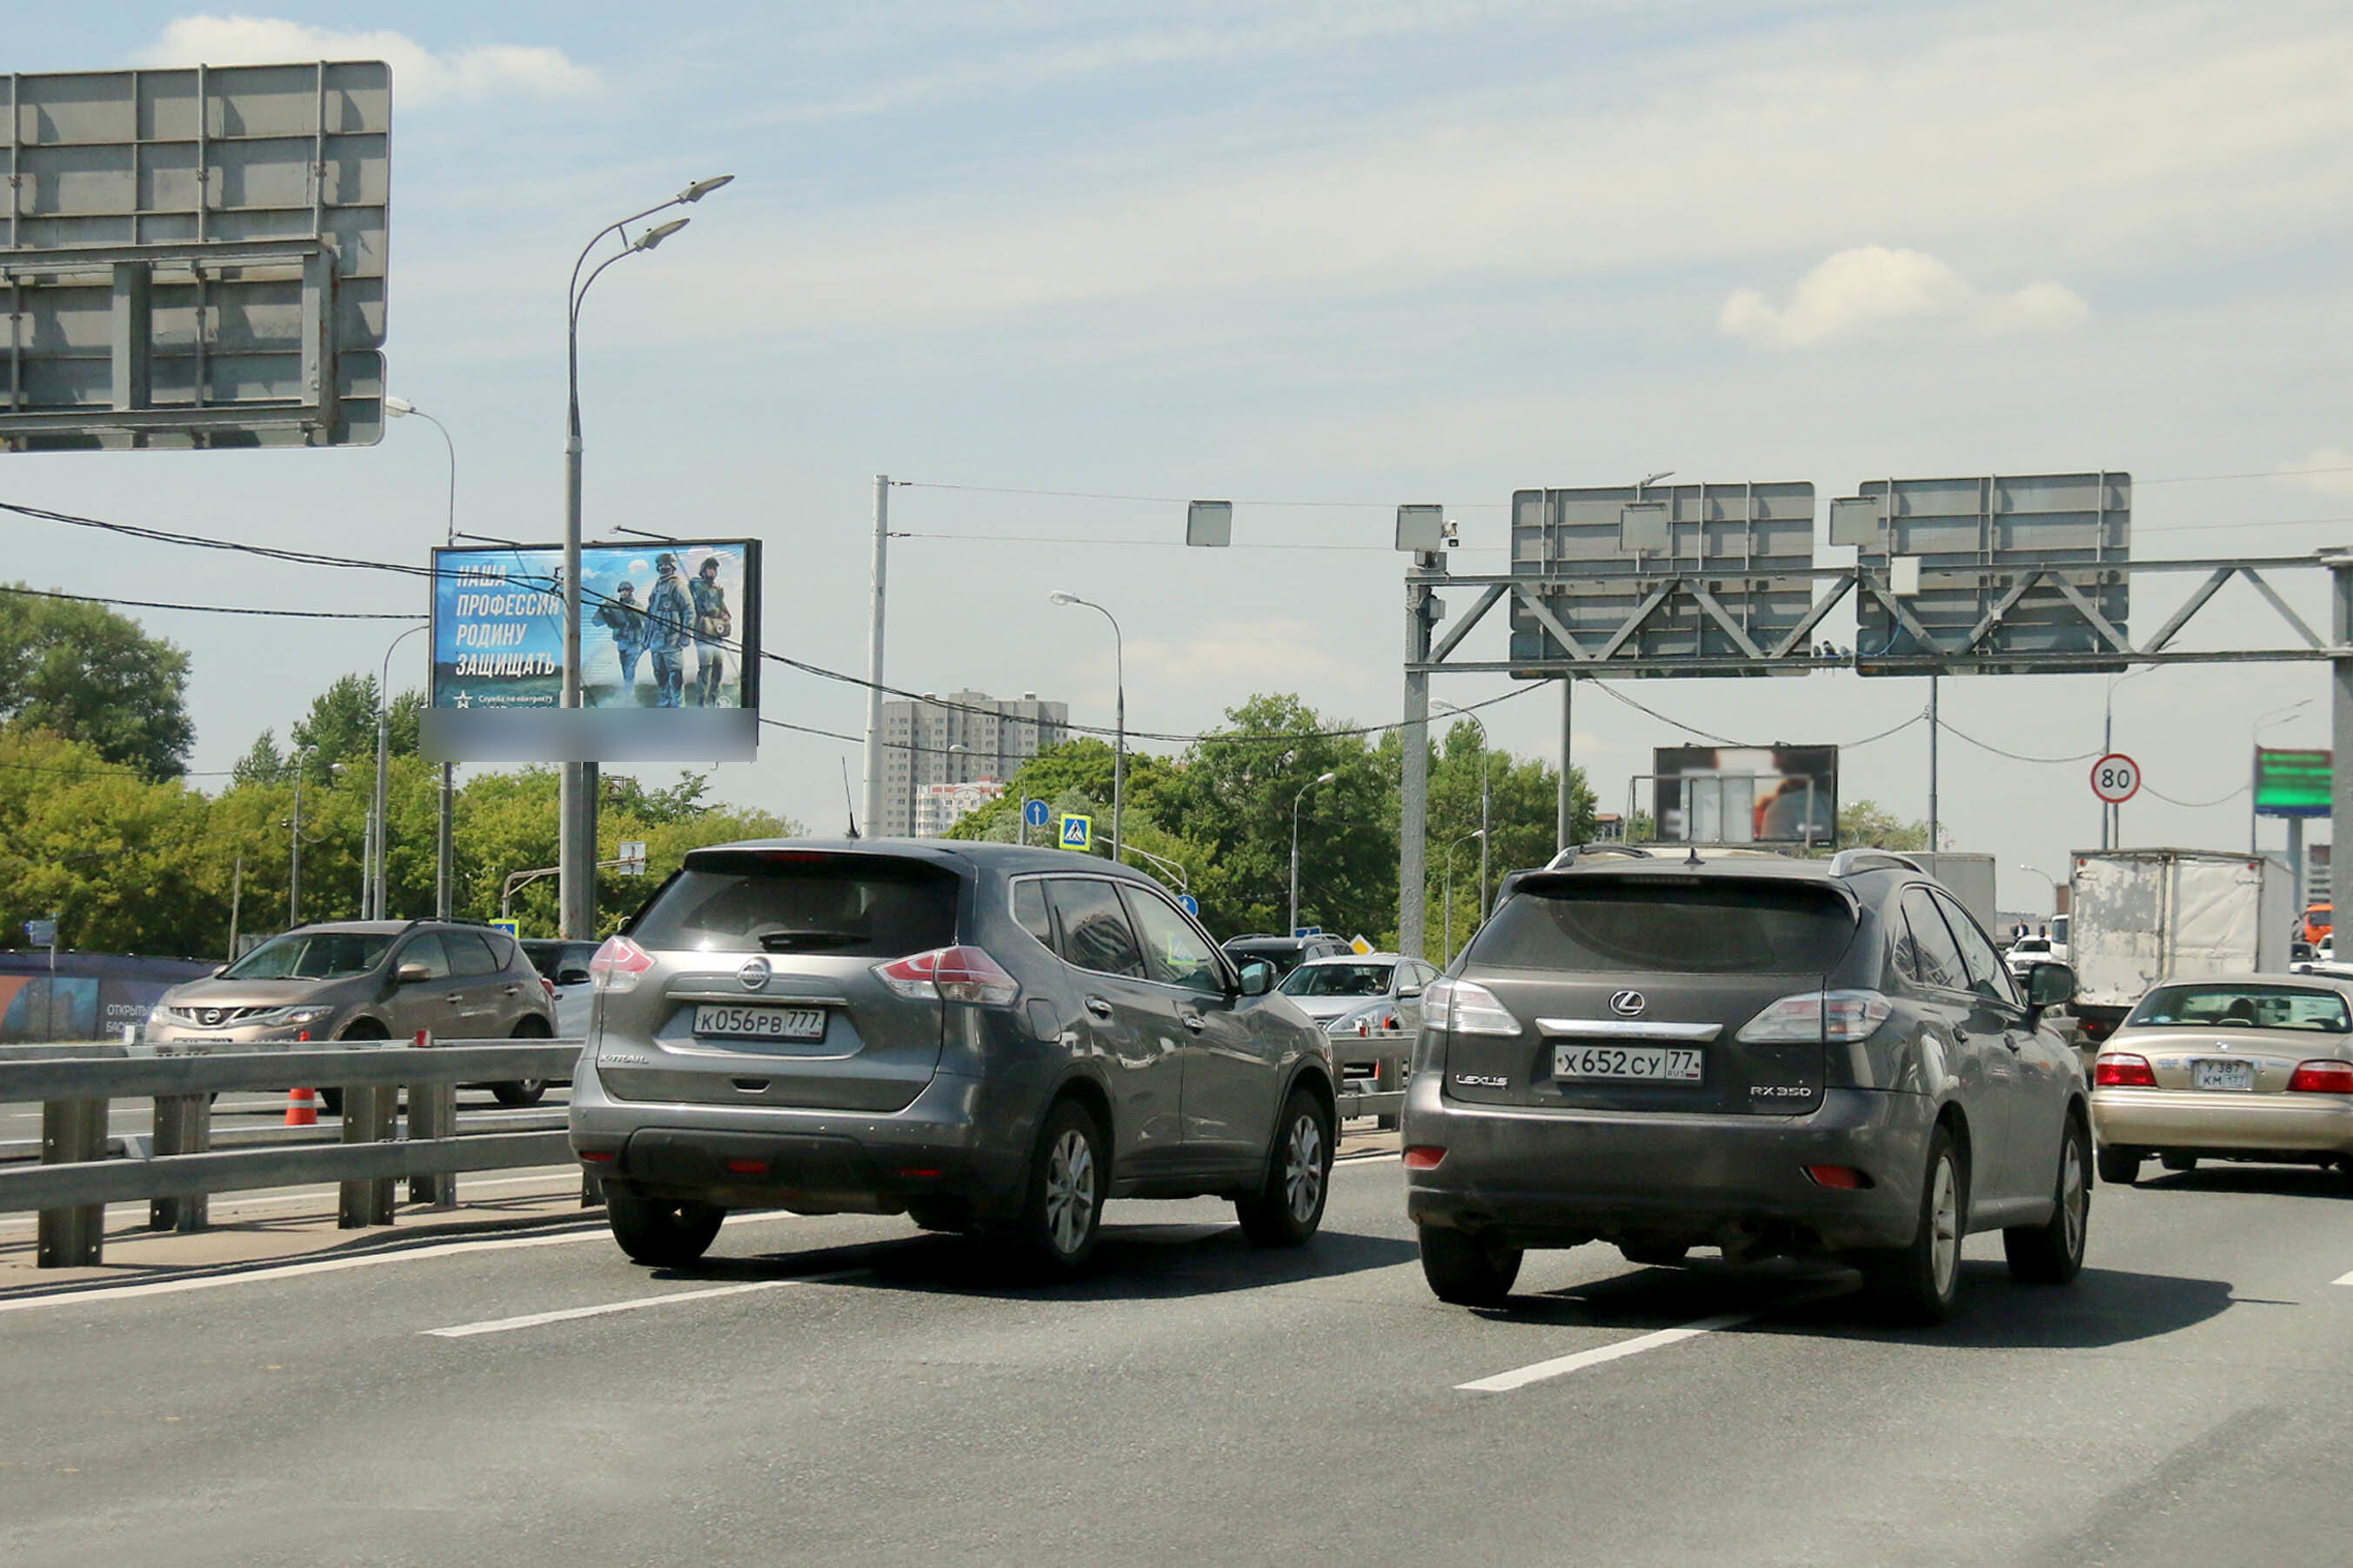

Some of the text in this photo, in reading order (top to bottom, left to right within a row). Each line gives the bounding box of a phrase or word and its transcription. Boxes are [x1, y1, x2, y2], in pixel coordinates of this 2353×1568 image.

[457, 564, 506, 587] НАША
[456, 593, 561, 617] ПРОФЕССИЯ
[456, 623, 527, 648] РОДИНУ
[456, 653, 555, 678] ЗАЩИЩАТЬ
[2102, 768, 2129, 789] 80
[788, 1011, 819, 1029] 777
[1564, 1049, 1693, 1075] Х652СУ 77
[1456, 1074, 1507, 1086] LEXUS
